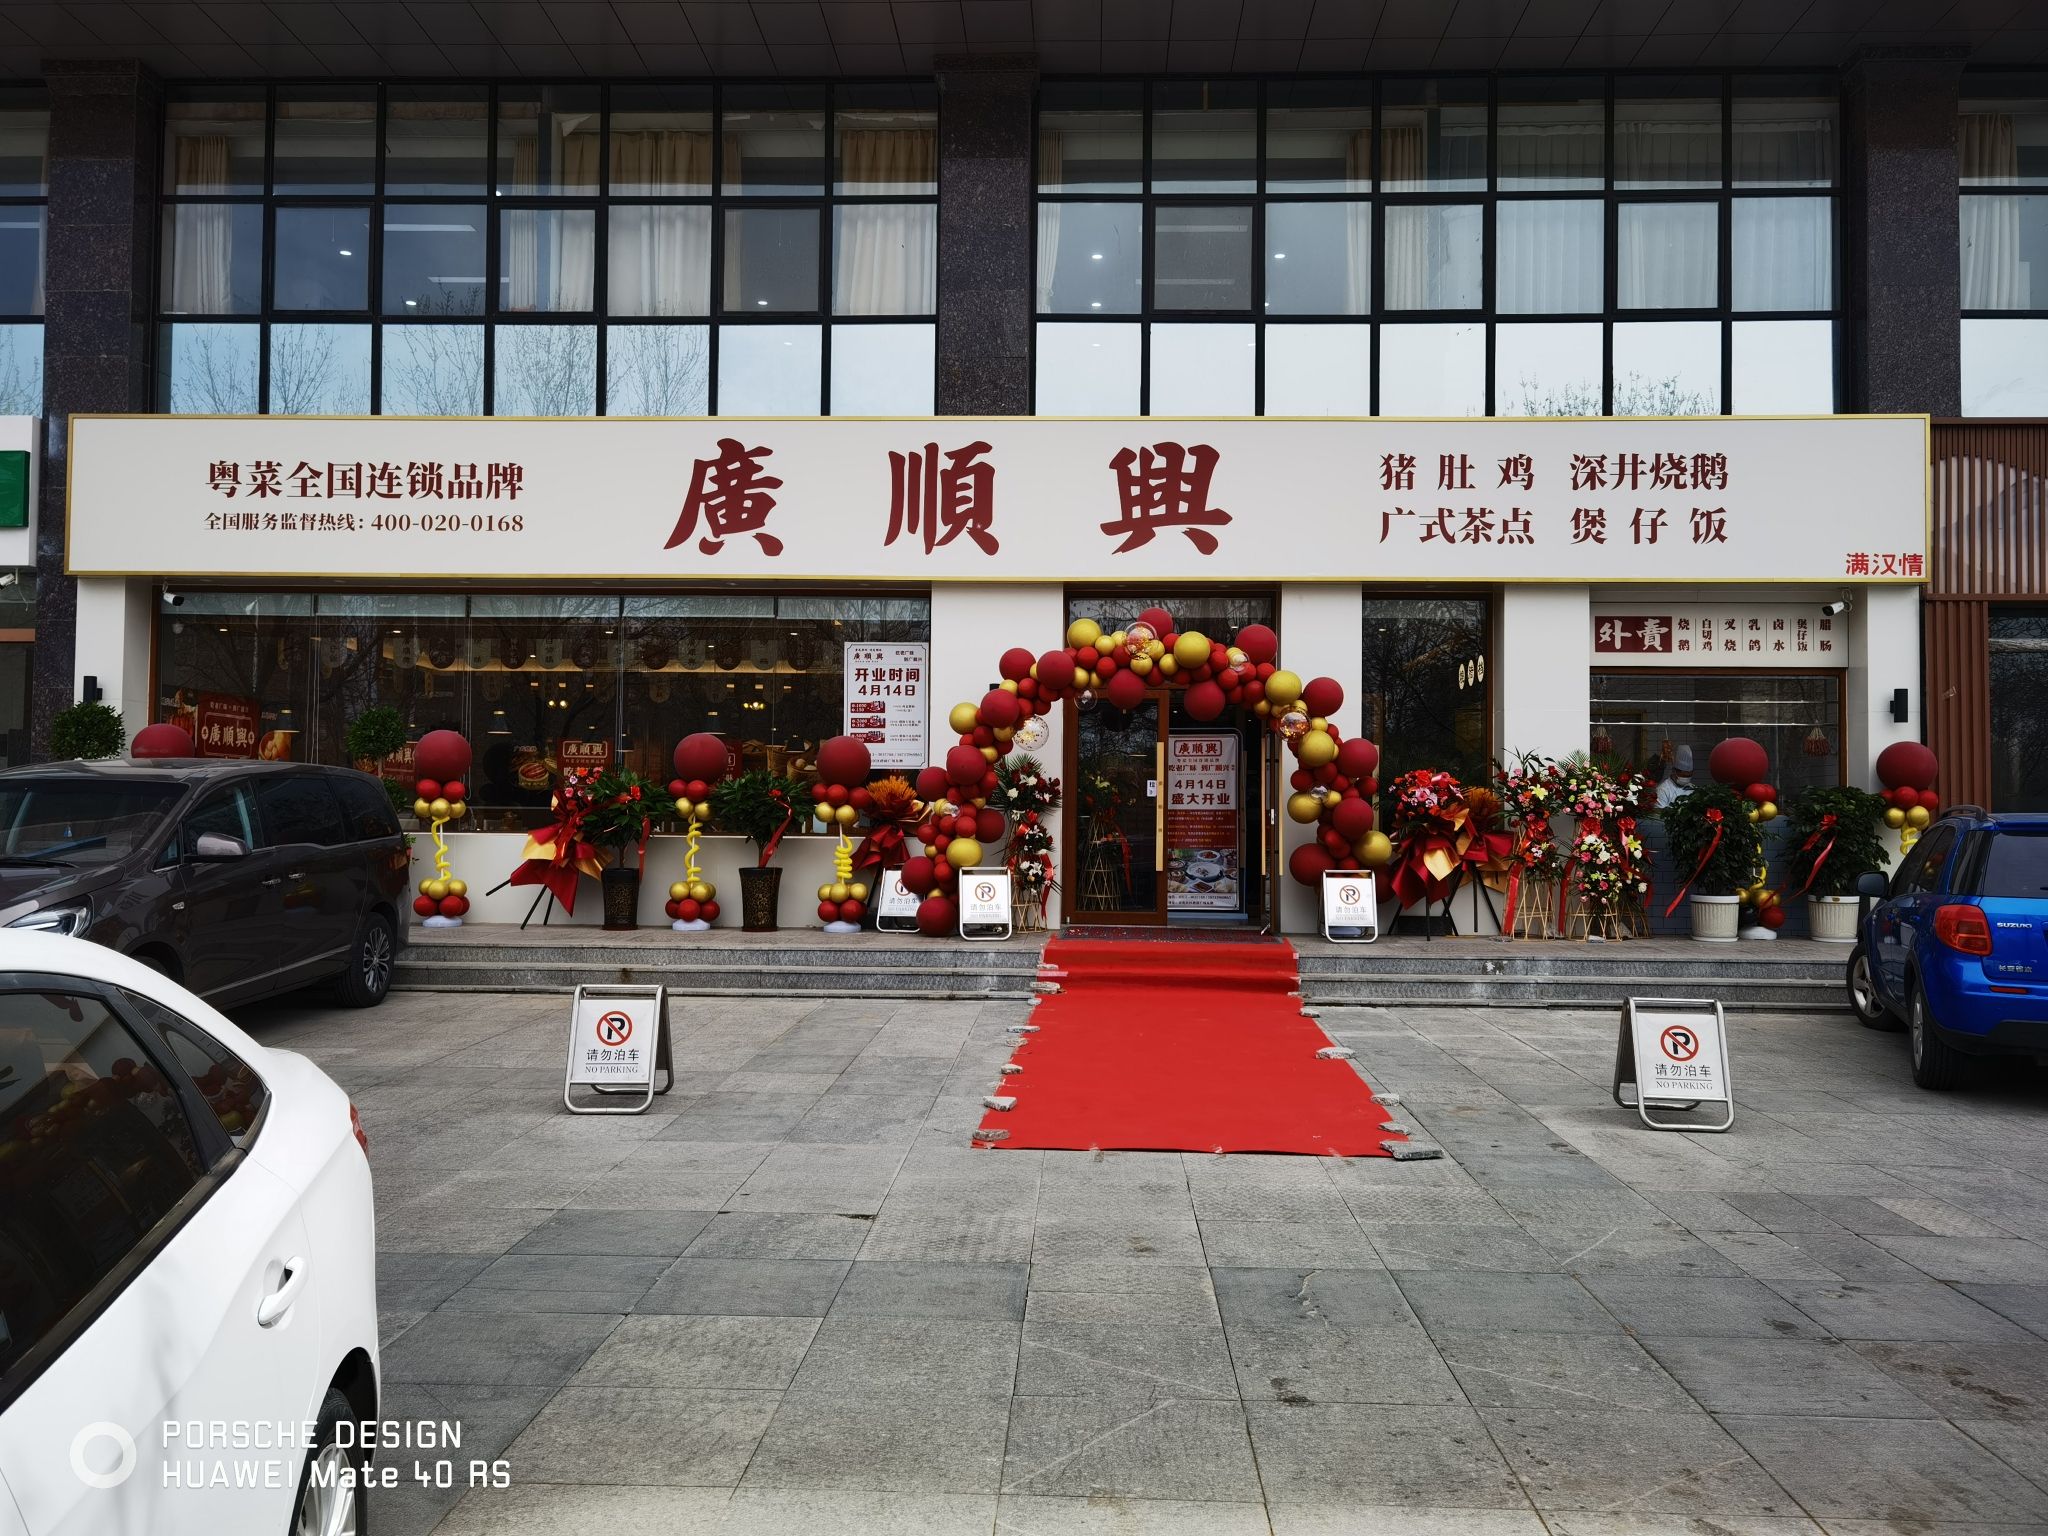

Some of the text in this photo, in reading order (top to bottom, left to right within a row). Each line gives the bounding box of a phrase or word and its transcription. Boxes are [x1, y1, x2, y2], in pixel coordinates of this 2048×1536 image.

[1379, 452, 1729, 491] 猪肚鸡 深井烧鹅
[205, 460, 524, 501] 粤菜全国连锁品牌
[664, 438, 1233, 556] 廣順興
[1379, 506, 1728, 545] 广式茶点 煲仔饭
[1845, 552, 1924, 577] 满汉情
[1701, 618, 1713, 652] 白切鸡
[854, 667, 920, 682] 开业时间
[857, 684, 916, 696] 4月14日
[208, 722, 248, 748] 廣順興
[1178, 742, 1218, 754] 廣順興
[1174, 779, 1227, 790] 4月14日
[1170, 792, 1231, 805] 盛大开业
[586, 1048, 640, 1062] 请勿泊车
[585, 1065, 639, 1074] NO PARKING
[1655, 1063, 1712, 1078] 请勿泊车
[1656, 1081, 1713, 1090] NO PARKING
